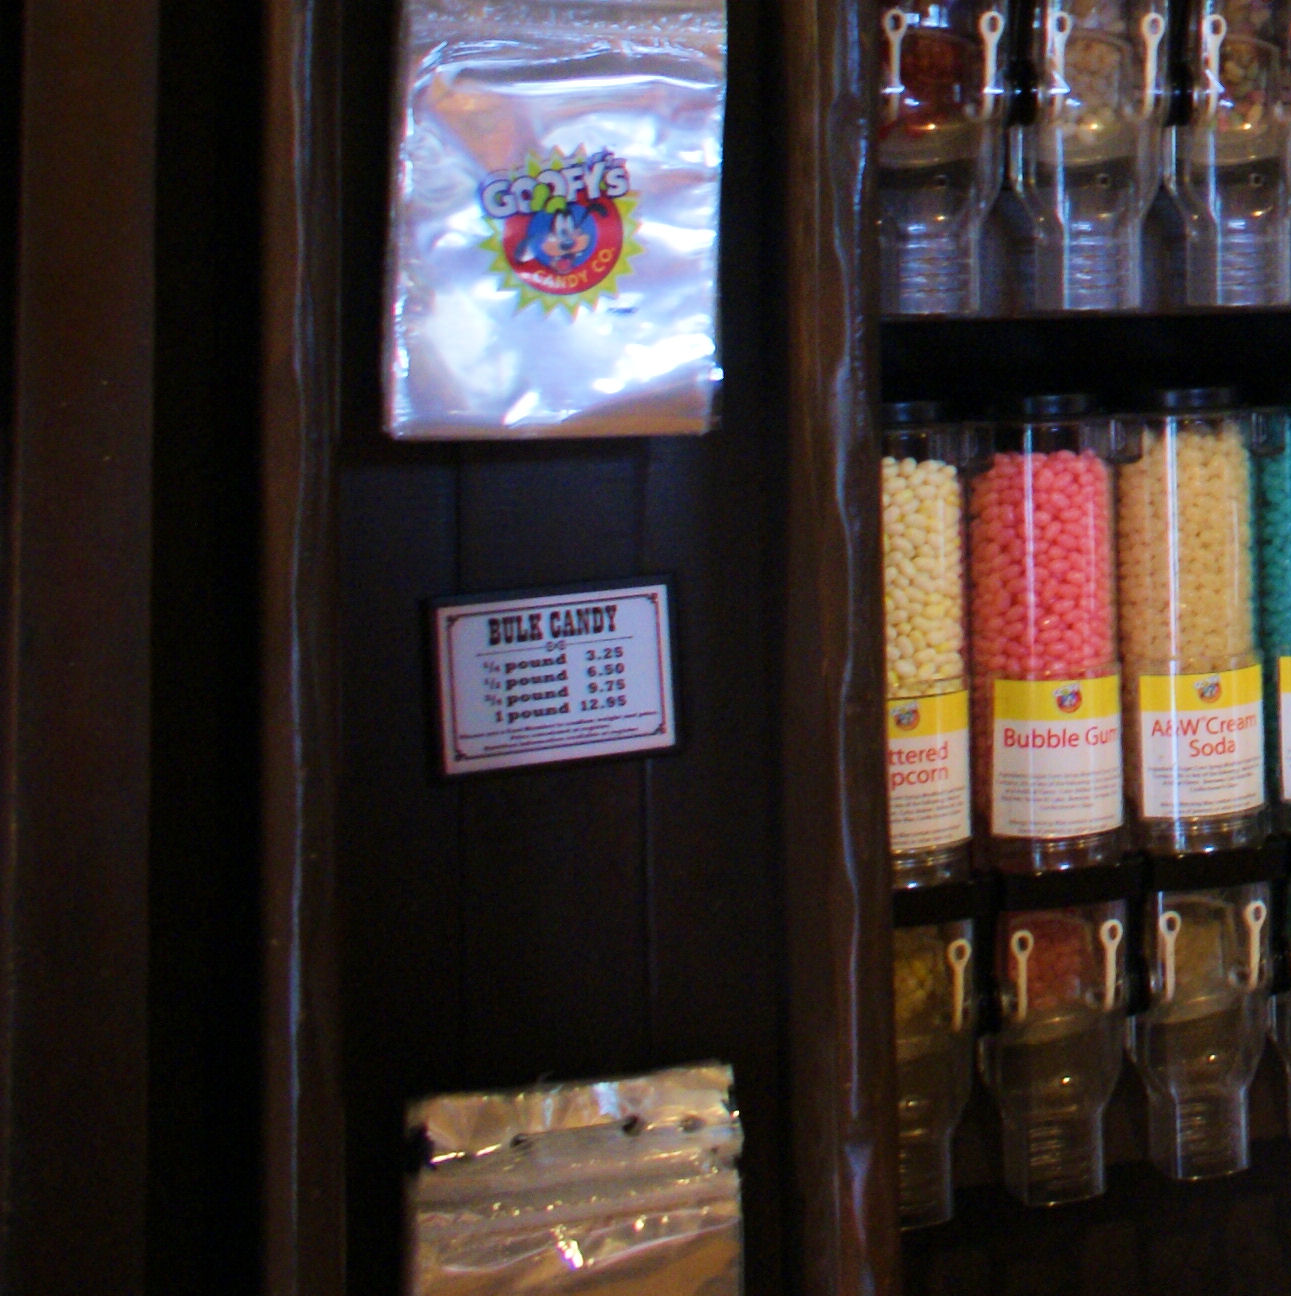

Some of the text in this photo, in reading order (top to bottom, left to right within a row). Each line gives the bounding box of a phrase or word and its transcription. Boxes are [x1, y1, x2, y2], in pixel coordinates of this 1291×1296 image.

[488, 604, 618, 647] BULK CANDY
[505, 653, 568, 674] pound
[586, 646, 624, 661] 3.25
[506, 669, 569, 691] pound
[587, 663, 625, 678] 6.50
[507, 686, 570, 707] pound
[588, 678, 626, 694] 9.75
[495, 694, 627, 724] 1 pound 12.95
[1004, 724, 1080, 749] Bubble
[1208, 713, 1258, 737] Cream
[888, 741, 949, 765] ttered
[1188, 737, 1237, 758] Soda
[890, 764, 950, 789] pcorn
